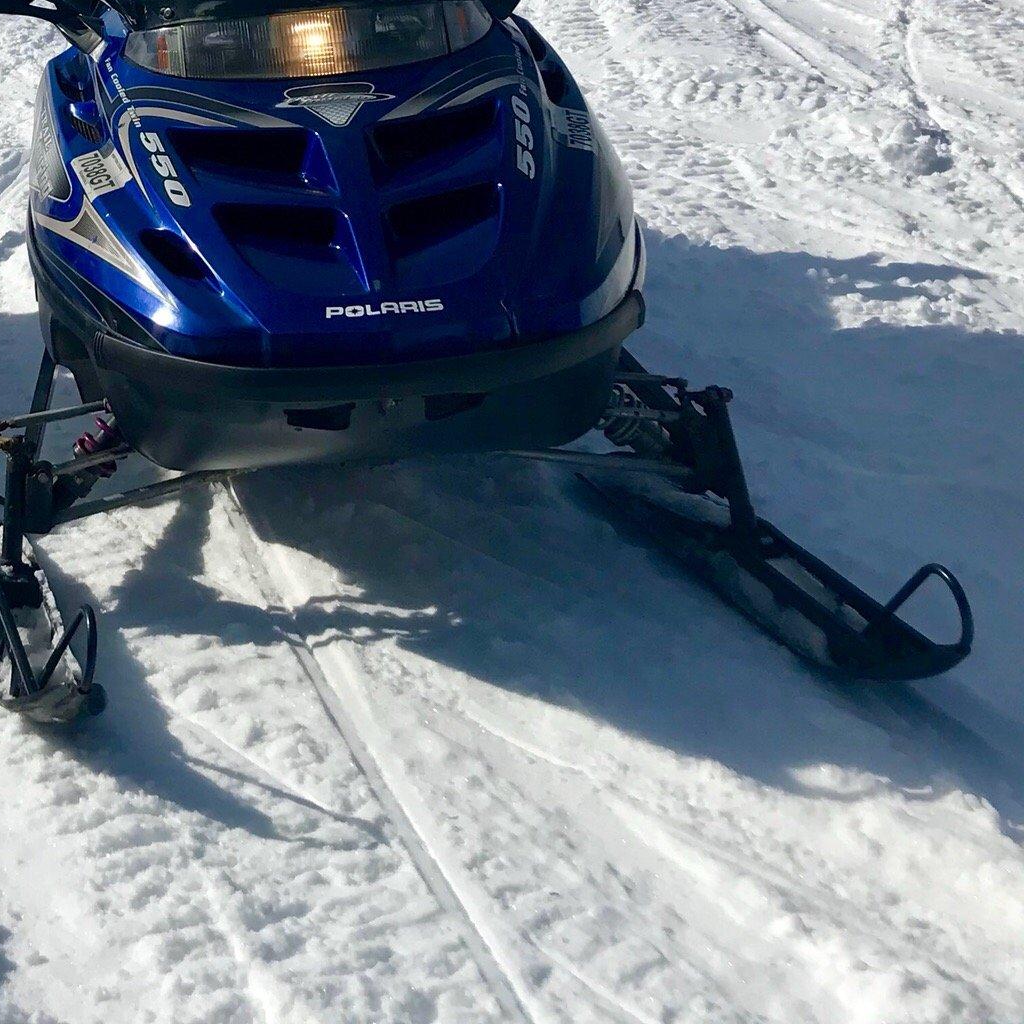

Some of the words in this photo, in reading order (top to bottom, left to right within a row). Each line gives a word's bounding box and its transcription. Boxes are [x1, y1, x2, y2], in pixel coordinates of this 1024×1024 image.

[104, 57, 113, 73] Fan
[110, 73, 131, 104] Cooled
[127, 105, 142, 128] Twin
[78, 153, 116, 191] 7038GT
[139, 132, 192, 208] 550
[511, 95, 536, 180] 550
[325, 298, 444, 319] POLARIS
